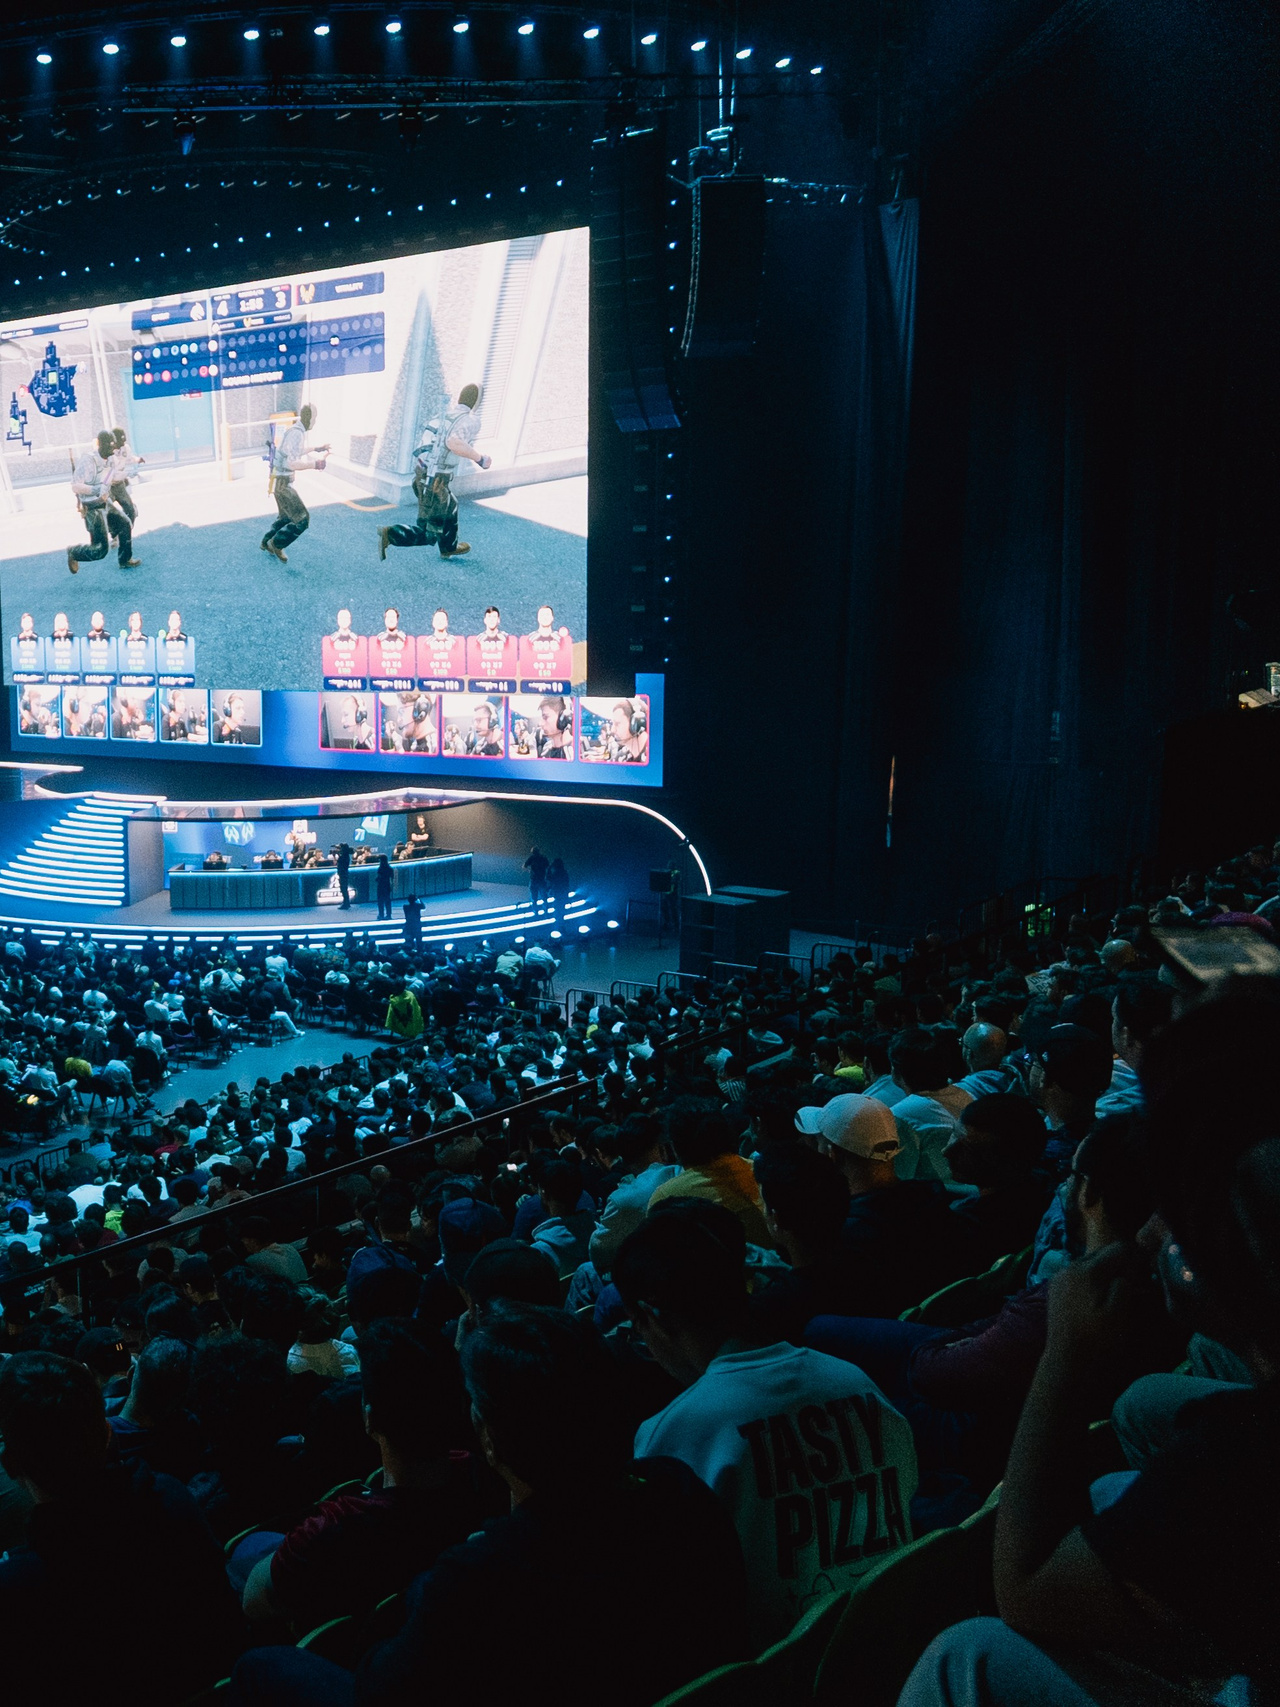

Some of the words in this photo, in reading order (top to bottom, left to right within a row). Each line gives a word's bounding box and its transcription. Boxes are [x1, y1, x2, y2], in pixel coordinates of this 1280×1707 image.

[217, 301, 228, 316] 4
[275, 291, 286, 308] 3
[738, 1392, 886, 1499] TASTY
[775, 1467, 907, 1579] PIZZA
